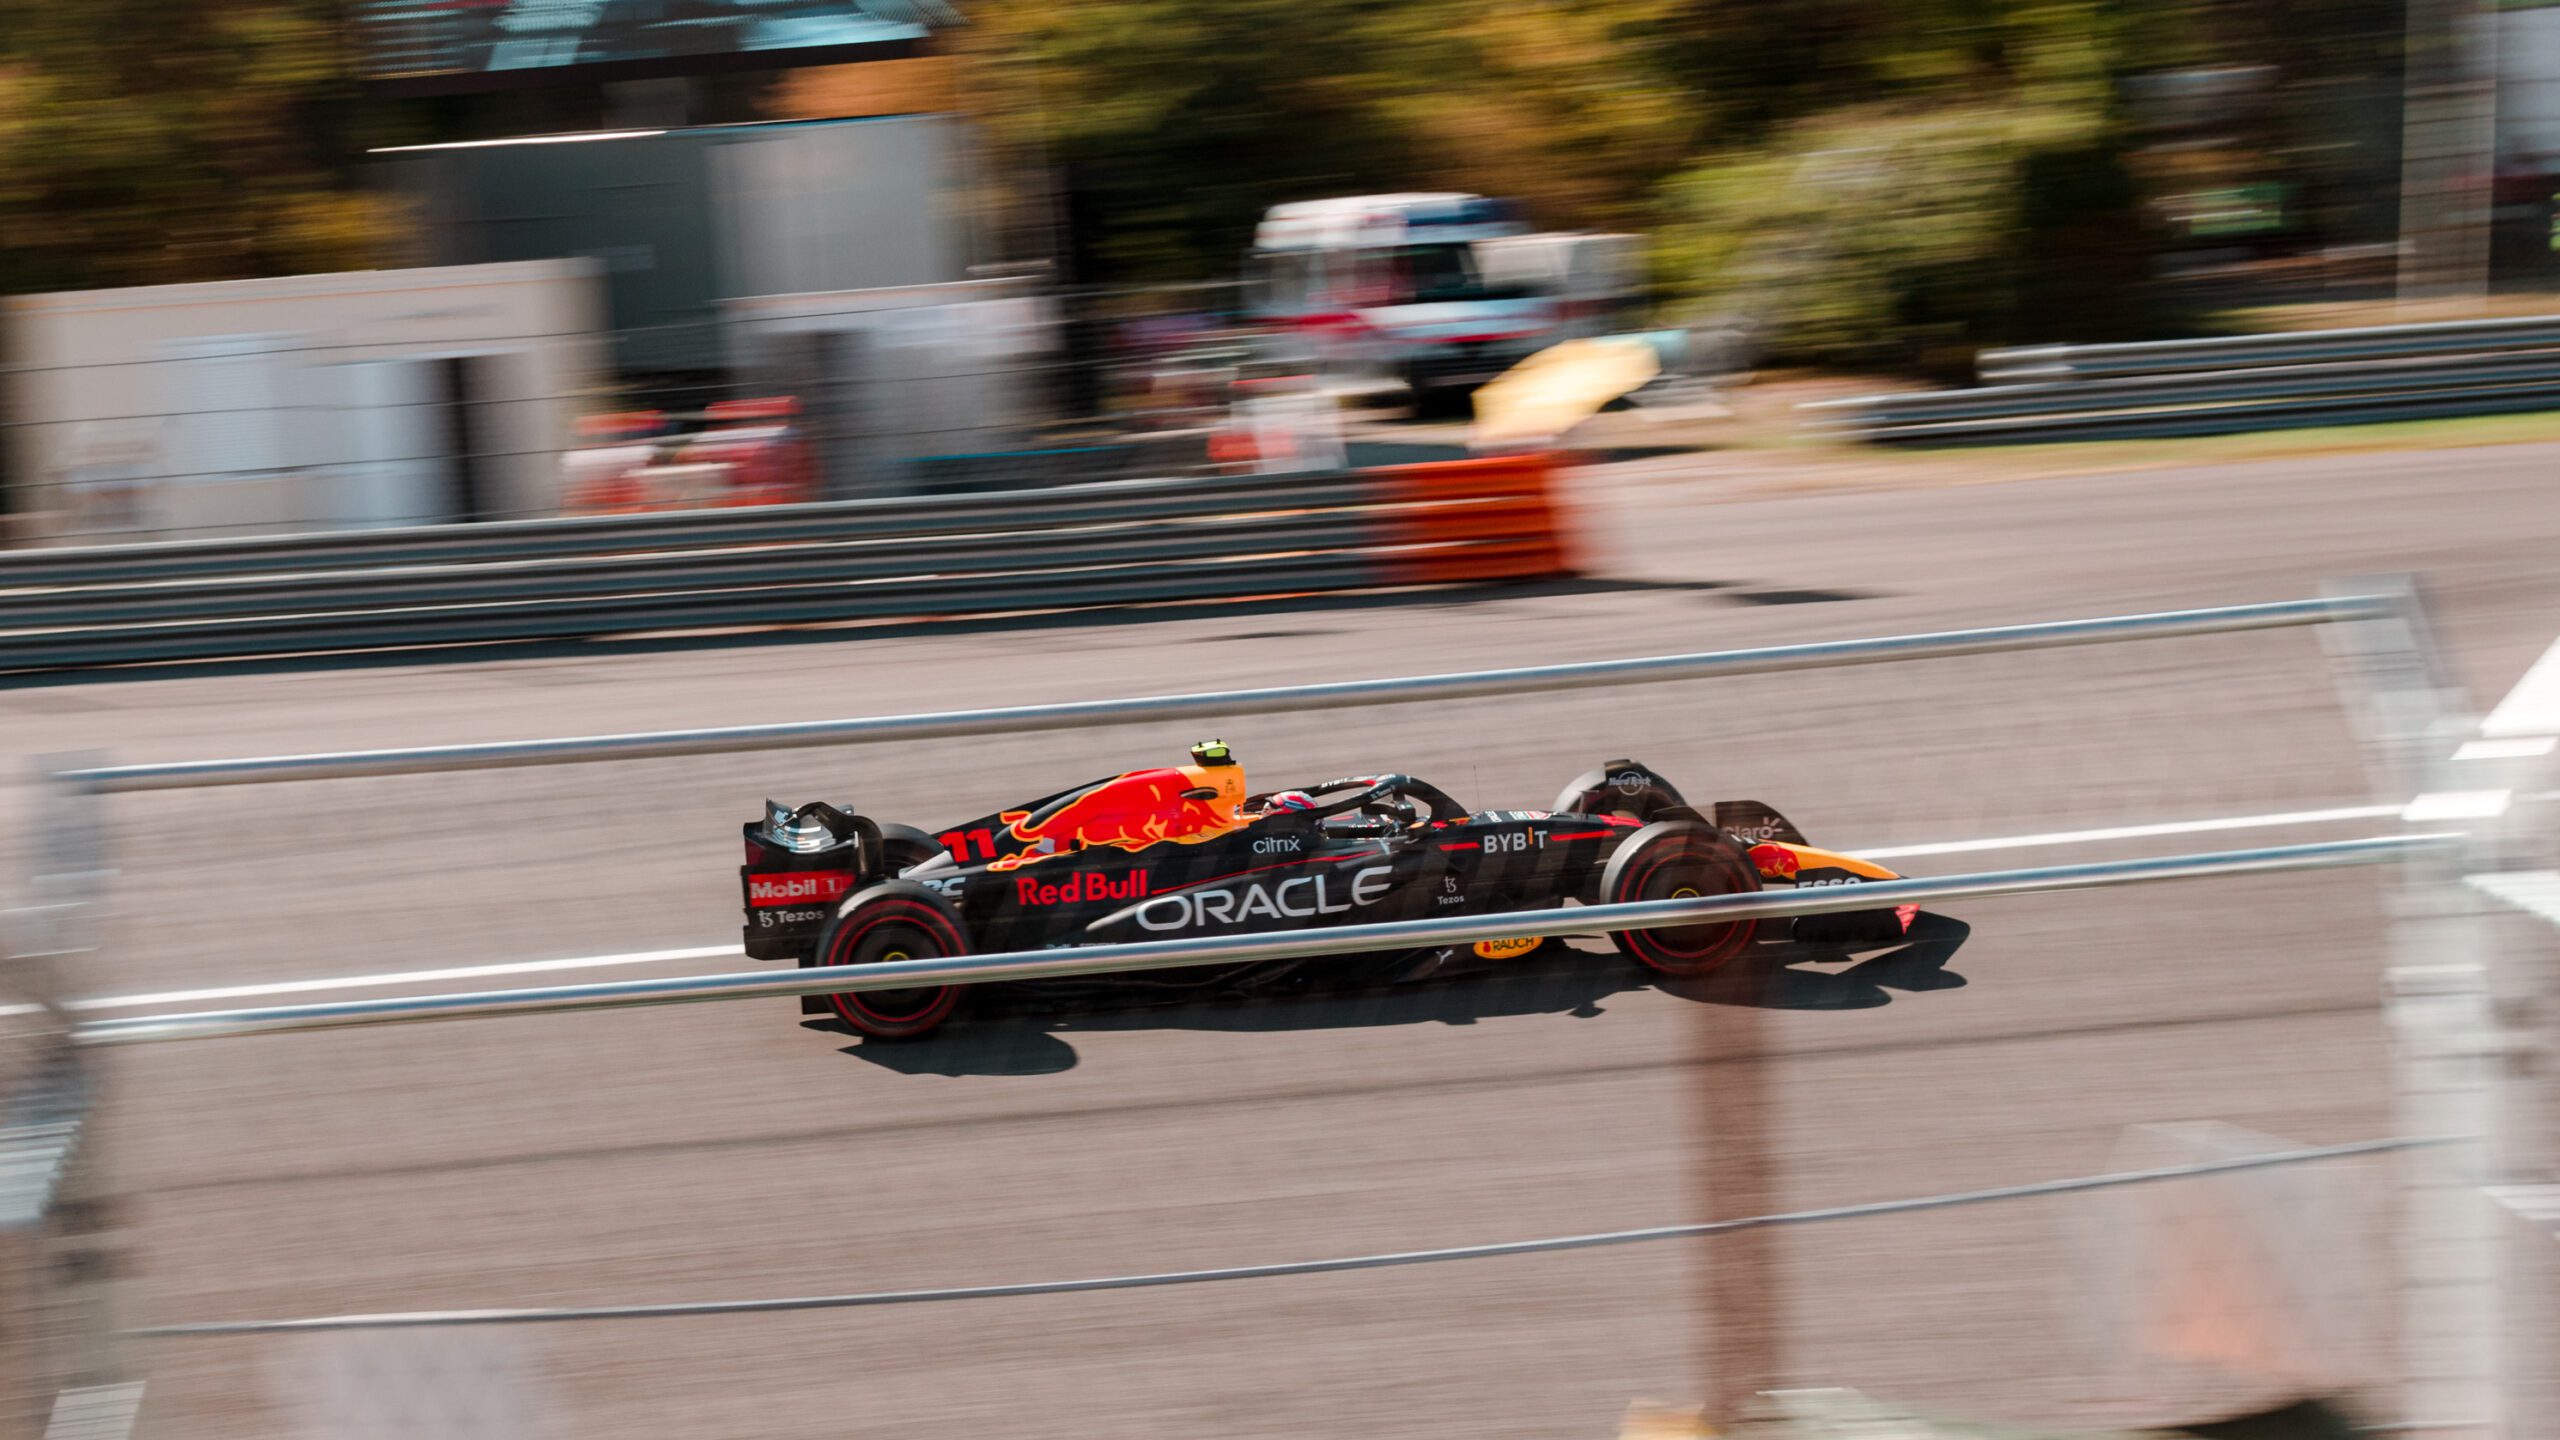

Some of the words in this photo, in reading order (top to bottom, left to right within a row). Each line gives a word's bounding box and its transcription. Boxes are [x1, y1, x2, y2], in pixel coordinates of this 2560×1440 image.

[938, 828, 997, 863] 11
[1252, 835, 1301, 854] citrix
[1483, 826, 1548, 854] BYBIT
[750, 879, 817, 899] Mobil
[1016, 871, 1081, 906] Red
[1086, 869, 1147, 901] Bull
[1136, 865, 1393, 931] ORACLE
[1437, 895, 1465, 905] Tezos
[776, 910, 825, 923] Tezos
[1493, 936, 1534, 951] RAUCH
